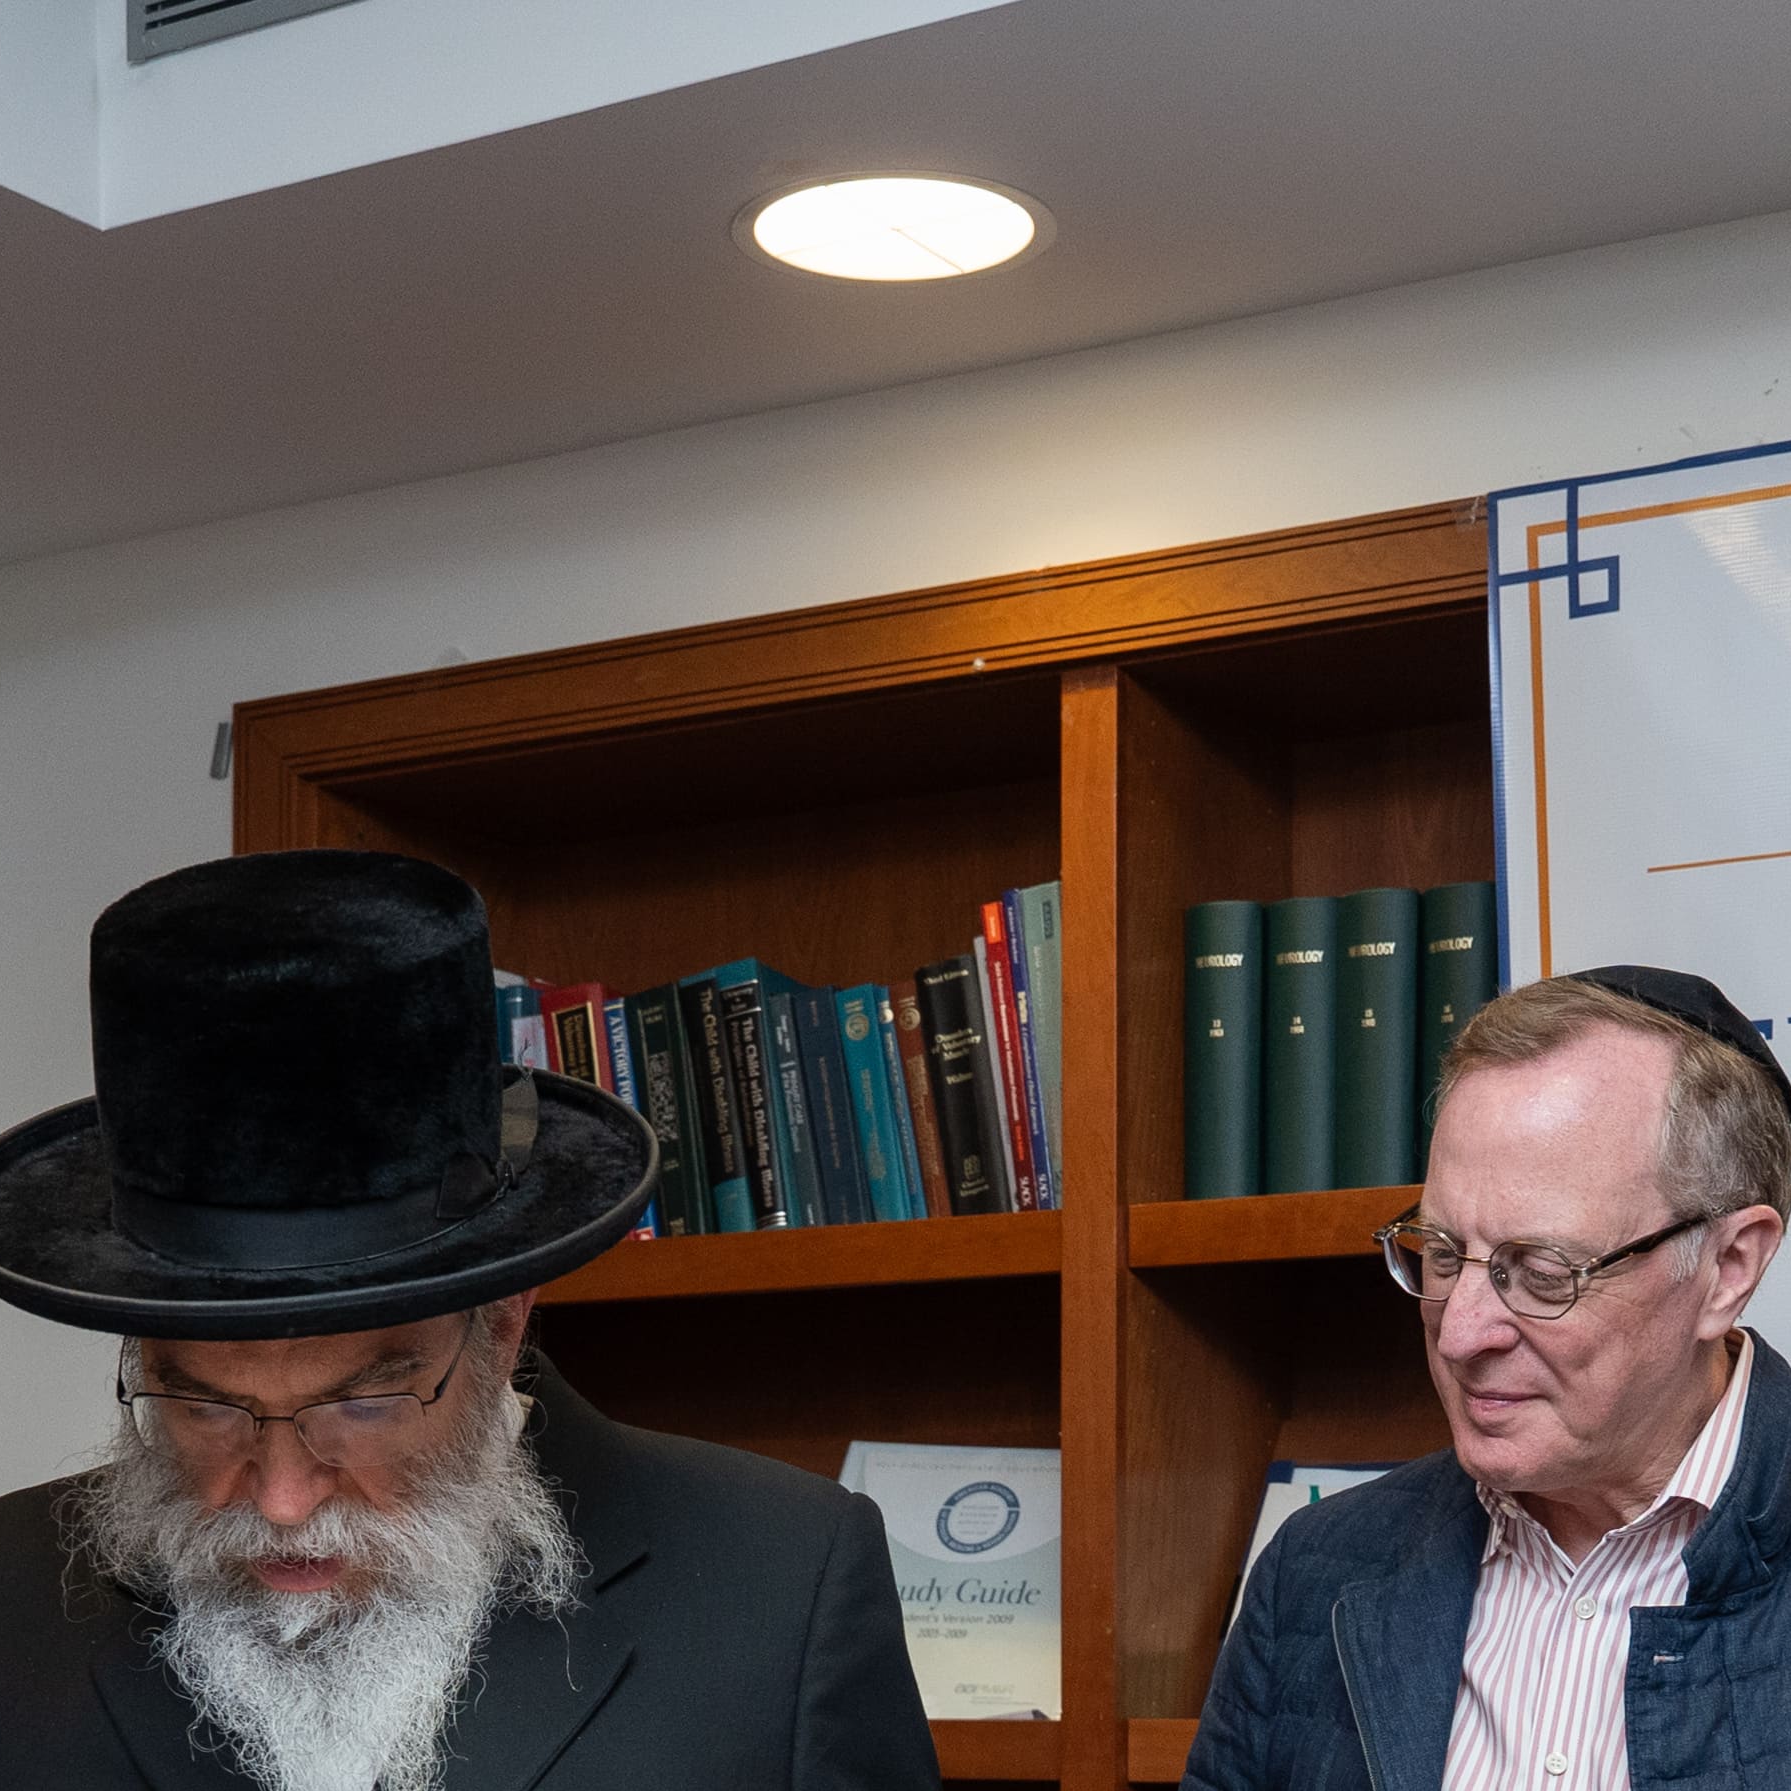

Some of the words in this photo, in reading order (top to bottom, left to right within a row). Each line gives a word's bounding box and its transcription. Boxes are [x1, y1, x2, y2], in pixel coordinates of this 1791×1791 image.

[742, 1017, 754, 1042] The
[746, 1044, 761, 1077] Child
[750, 1079, 764, 1108] with
[1020, 1176, 1032, 1206] SLACK
[955, 1578, 1041, 1606] Guide
